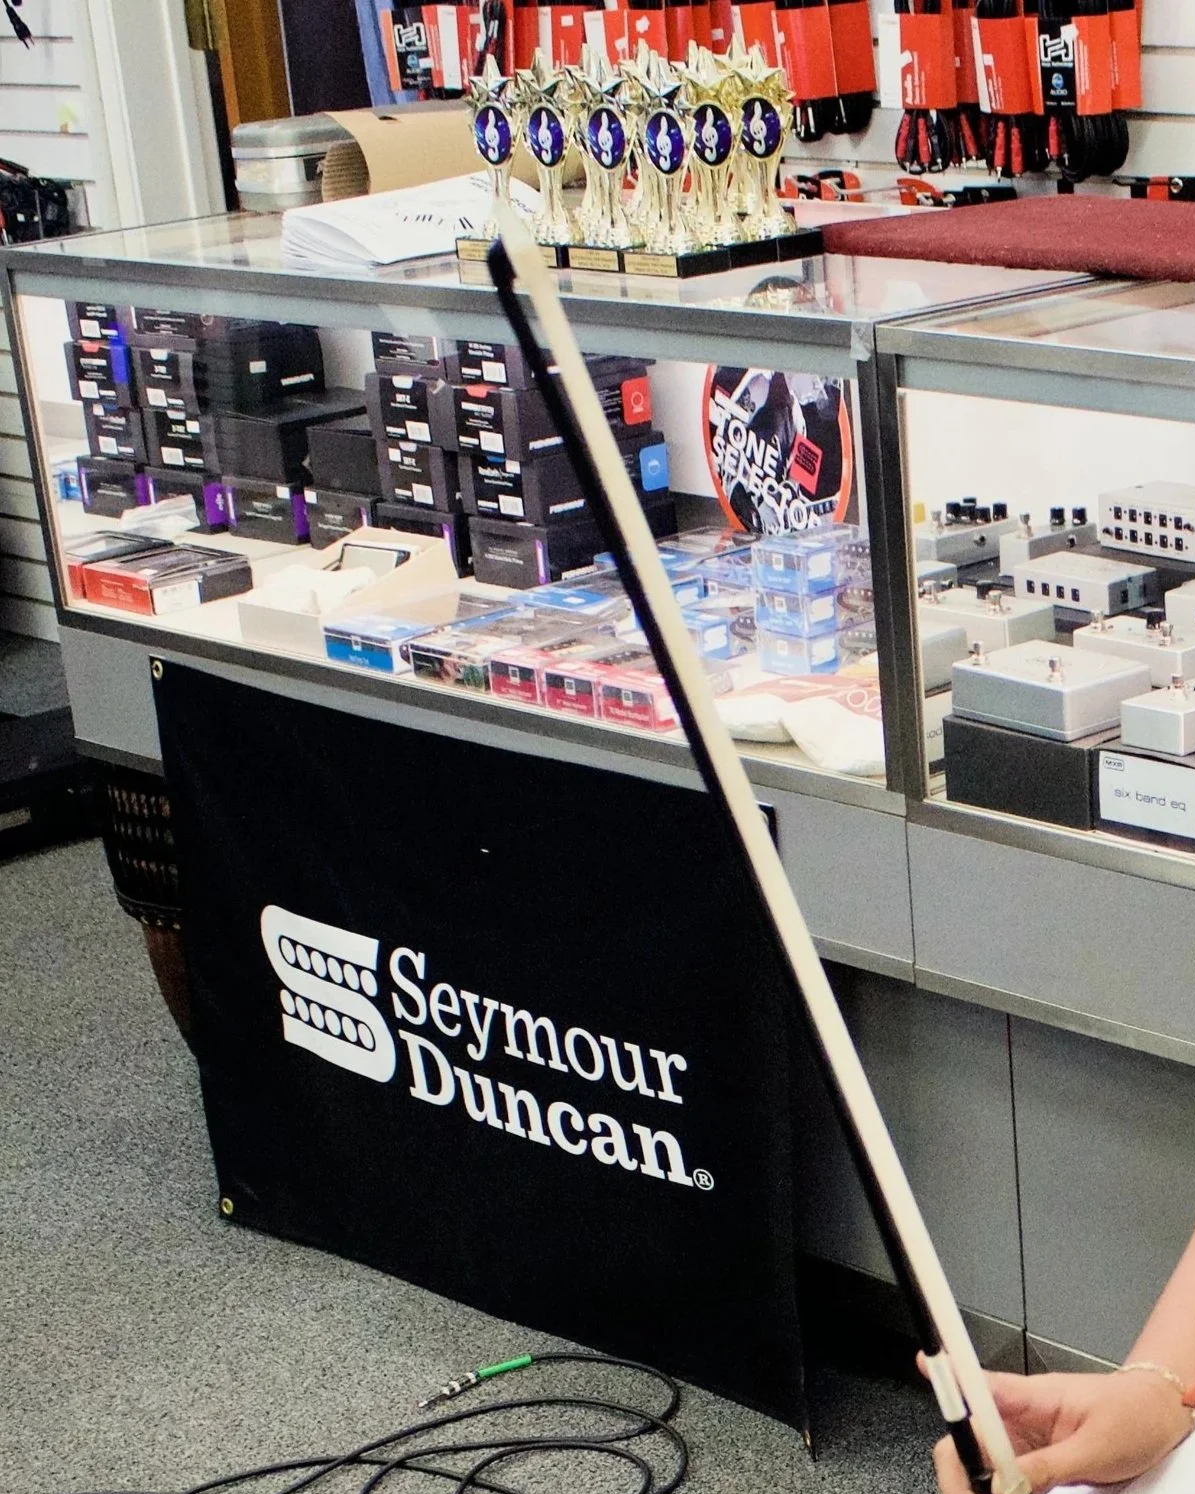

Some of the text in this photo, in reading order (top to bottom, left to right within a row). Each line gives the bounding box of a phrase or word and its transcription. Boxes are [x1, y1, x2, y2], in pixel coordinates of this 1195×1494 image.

[709, 411, 780, 480] TONE
[1105, 759, 1123, 769] MXR
[1113, 787, 1188, 812] six band eq
[389, 945, 688, 1106] Seymour
